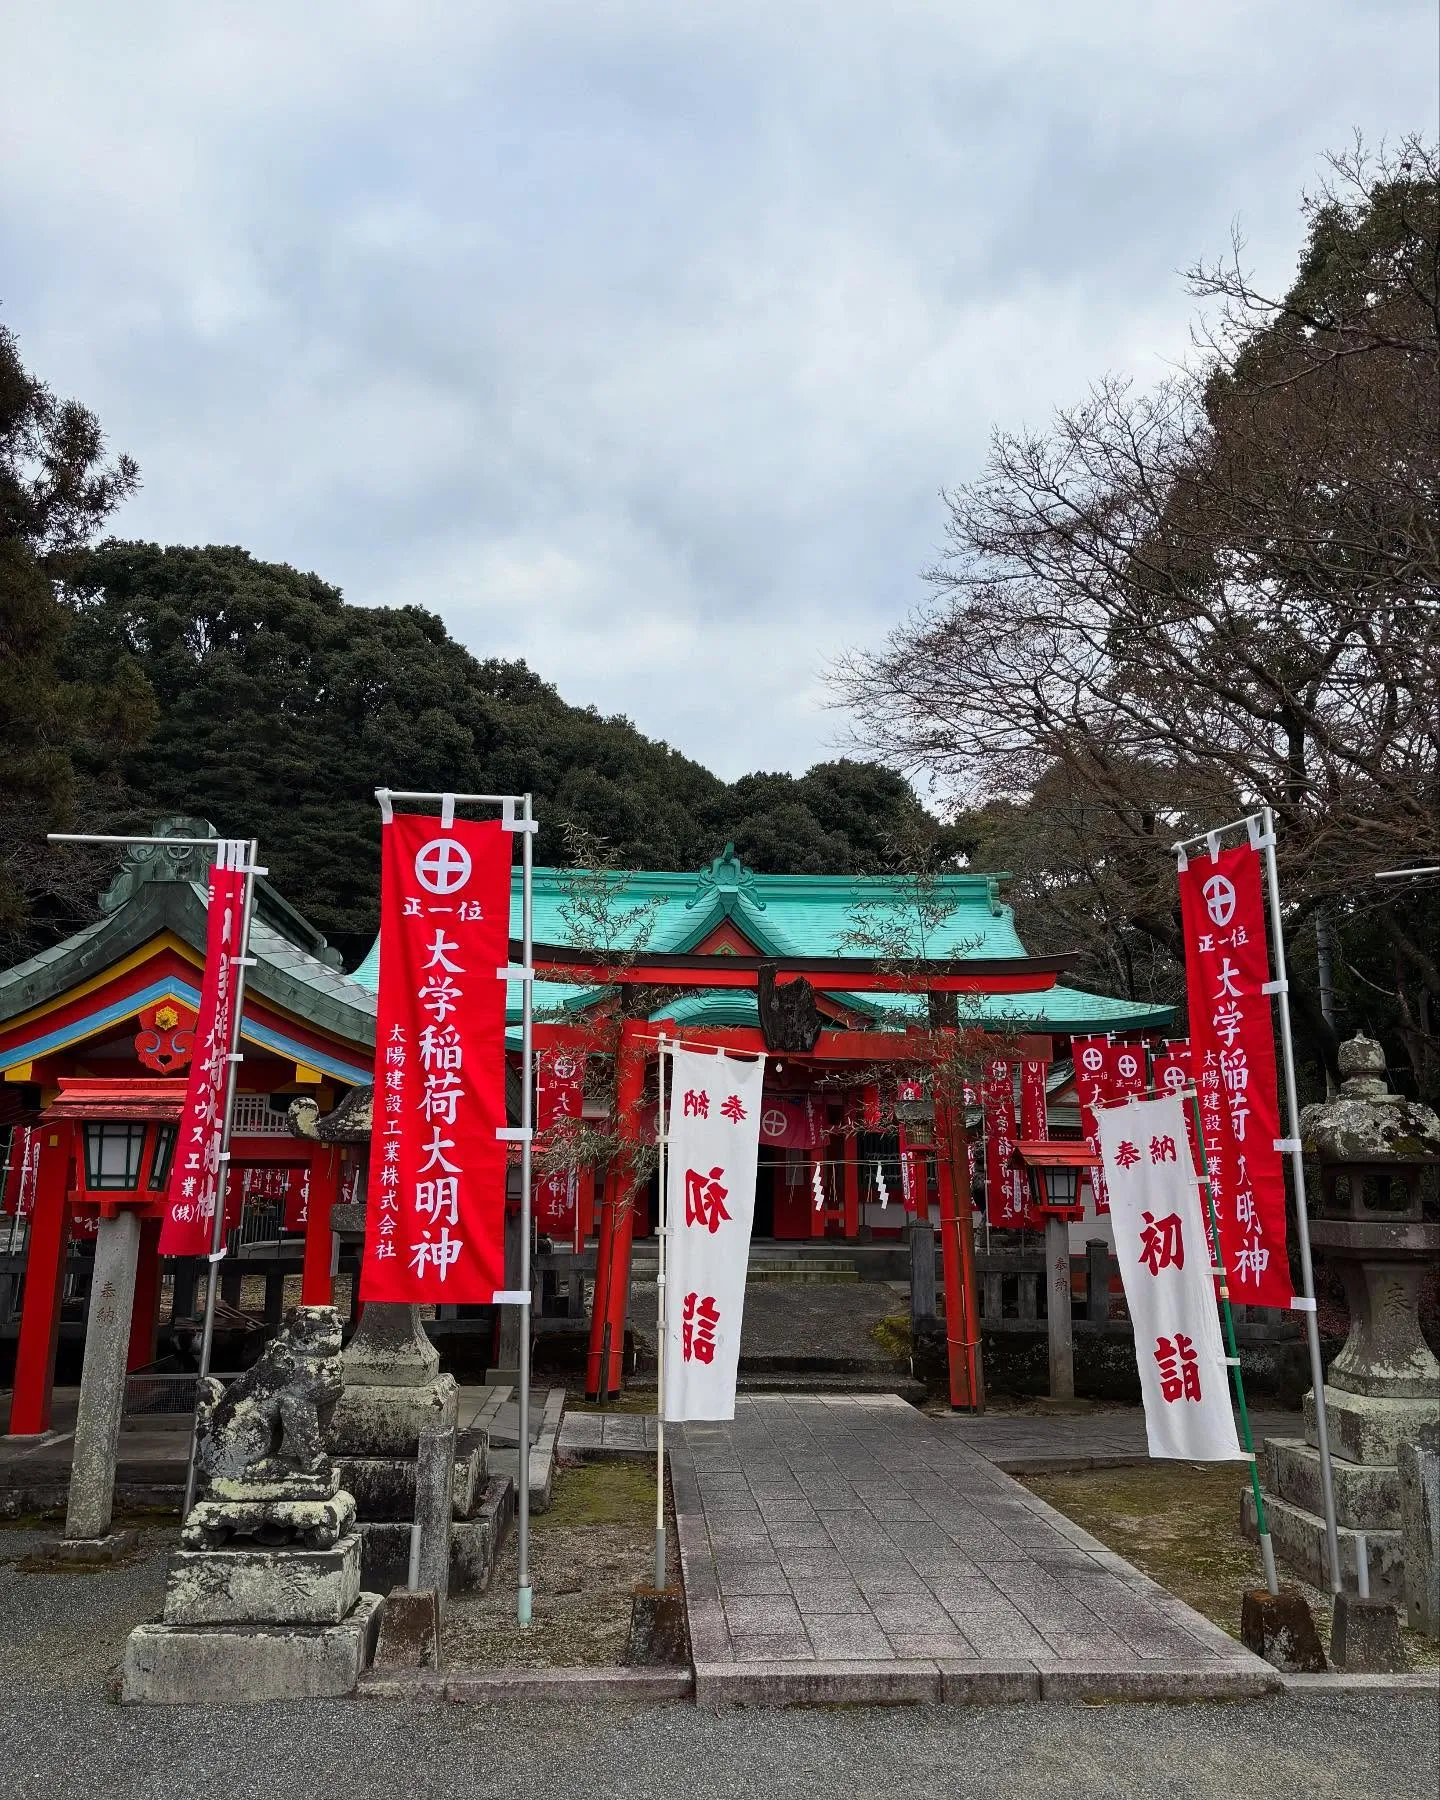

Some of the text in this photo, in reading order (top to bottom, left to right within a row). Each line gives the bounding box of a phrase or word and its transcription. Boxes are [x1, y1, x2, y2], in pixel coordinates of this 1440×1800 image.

[402, 896, 485, 922] 正一位
[1198, 925, 1249, 953] 正一位
[375, 1023, 408, 1260] 太陽建設工業株式会社
[408, 928, 467, 1284] 大学稲荷大明神
[1113, 1134, 1178, 1170] 奉納
[1138, 1211, 1202, 1404] 初詣
